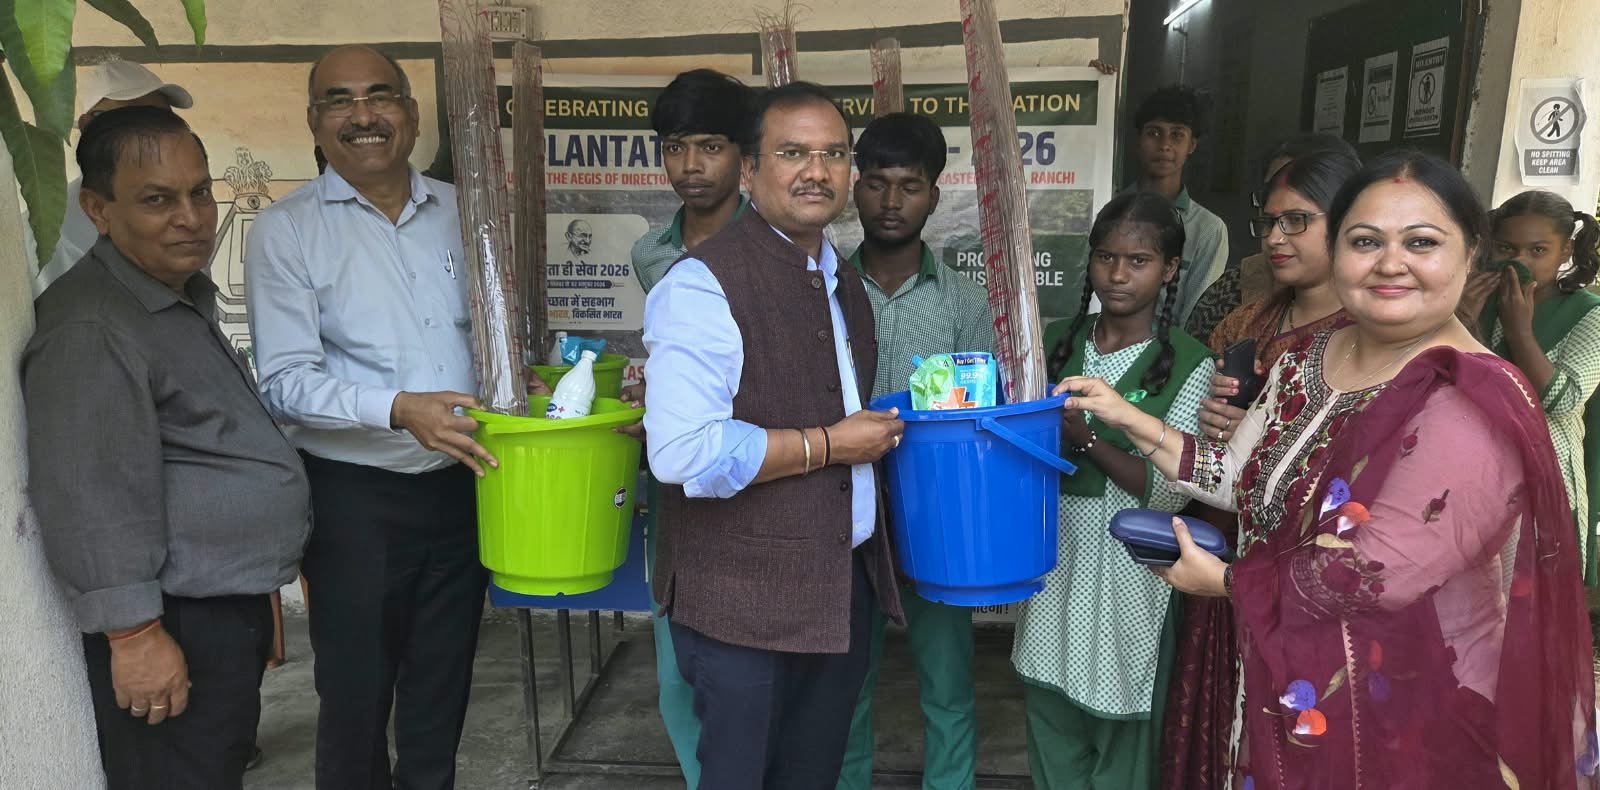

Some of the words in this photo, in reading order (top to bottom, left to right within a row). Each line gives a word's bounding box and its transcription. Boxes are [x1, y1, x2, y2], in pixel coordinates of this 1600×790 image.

[505, 98, 649, 118] CEBRATING
[909, 97, 938, 115] TO
[943, 96, 970, 114] TH
[1012, 93, 1081, 113] ATION
[1530, 150, 1541, 159] NO
[1541, 150, 1571, 159] SPITTING
[1531, 158, 1548, 166] KEEP
[1549, 158, 1567, 166] AREA
[1538, 166, 1560, 175] CLEAN
[546, 172, 567, 185] THE
[570, 172, 602, 185] AEGIS
[606, 172, 620, 185] OF
[1030, 171, 1075, 185] RANCHI
[956, 251, 1051, 267] PRONG
[561, 260, 573, 276] ही
[575, 260, 597, 276] सेवा
[600, 263, 630, 277] 2026
[569, 293, 581, 307] में
[571, 308, 602, 319] विकसित
[602, 310, 624, 319] भारत
